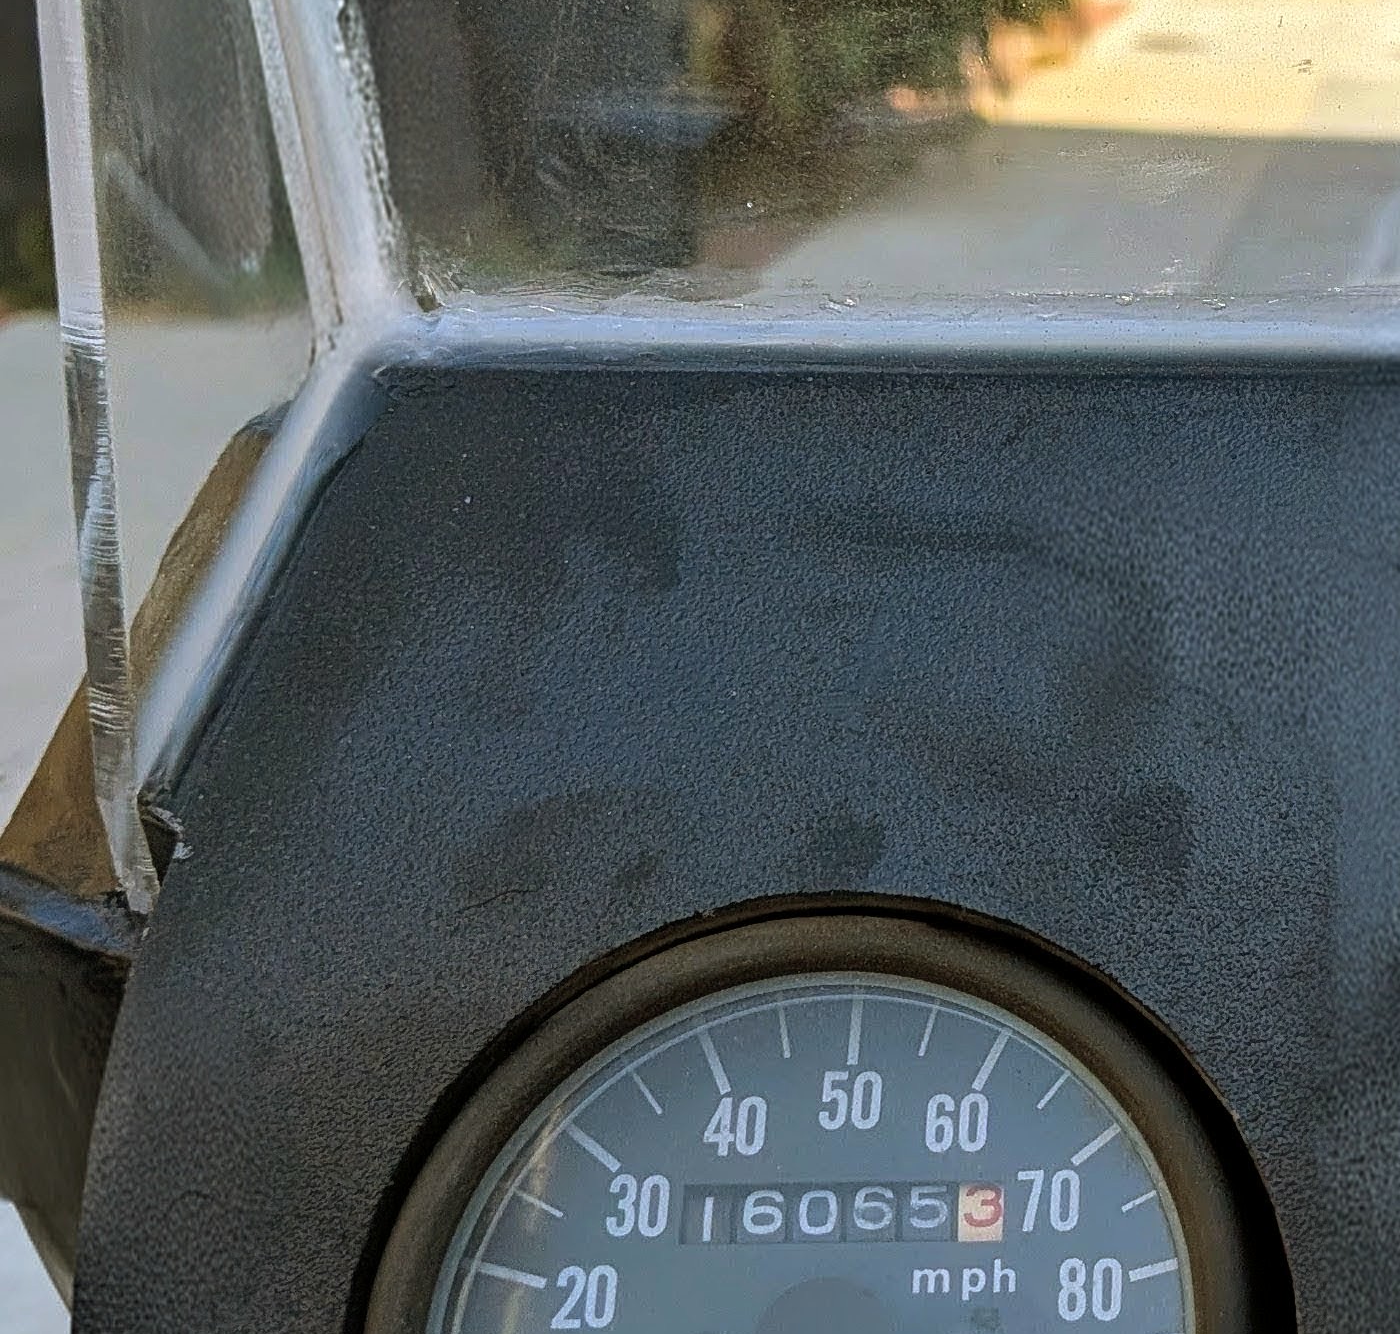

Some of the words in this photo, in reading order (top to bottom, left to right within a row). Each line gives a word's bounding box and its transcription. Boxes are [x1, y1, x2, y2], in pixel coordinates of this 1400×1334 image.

[703, 1096, 767, 1158] 40
[818, 1071, 881, 1130] 50
[925, 1092, 988, 1153] 60
[606, 1174, 670, 1238] 30
[1017, 1169, 1080, 1232] 70
[550, 1265, 617, 1330] 20
[911, 1259, 1017, 1301] mph
[1057, 1257, 1122, 1323] 80
